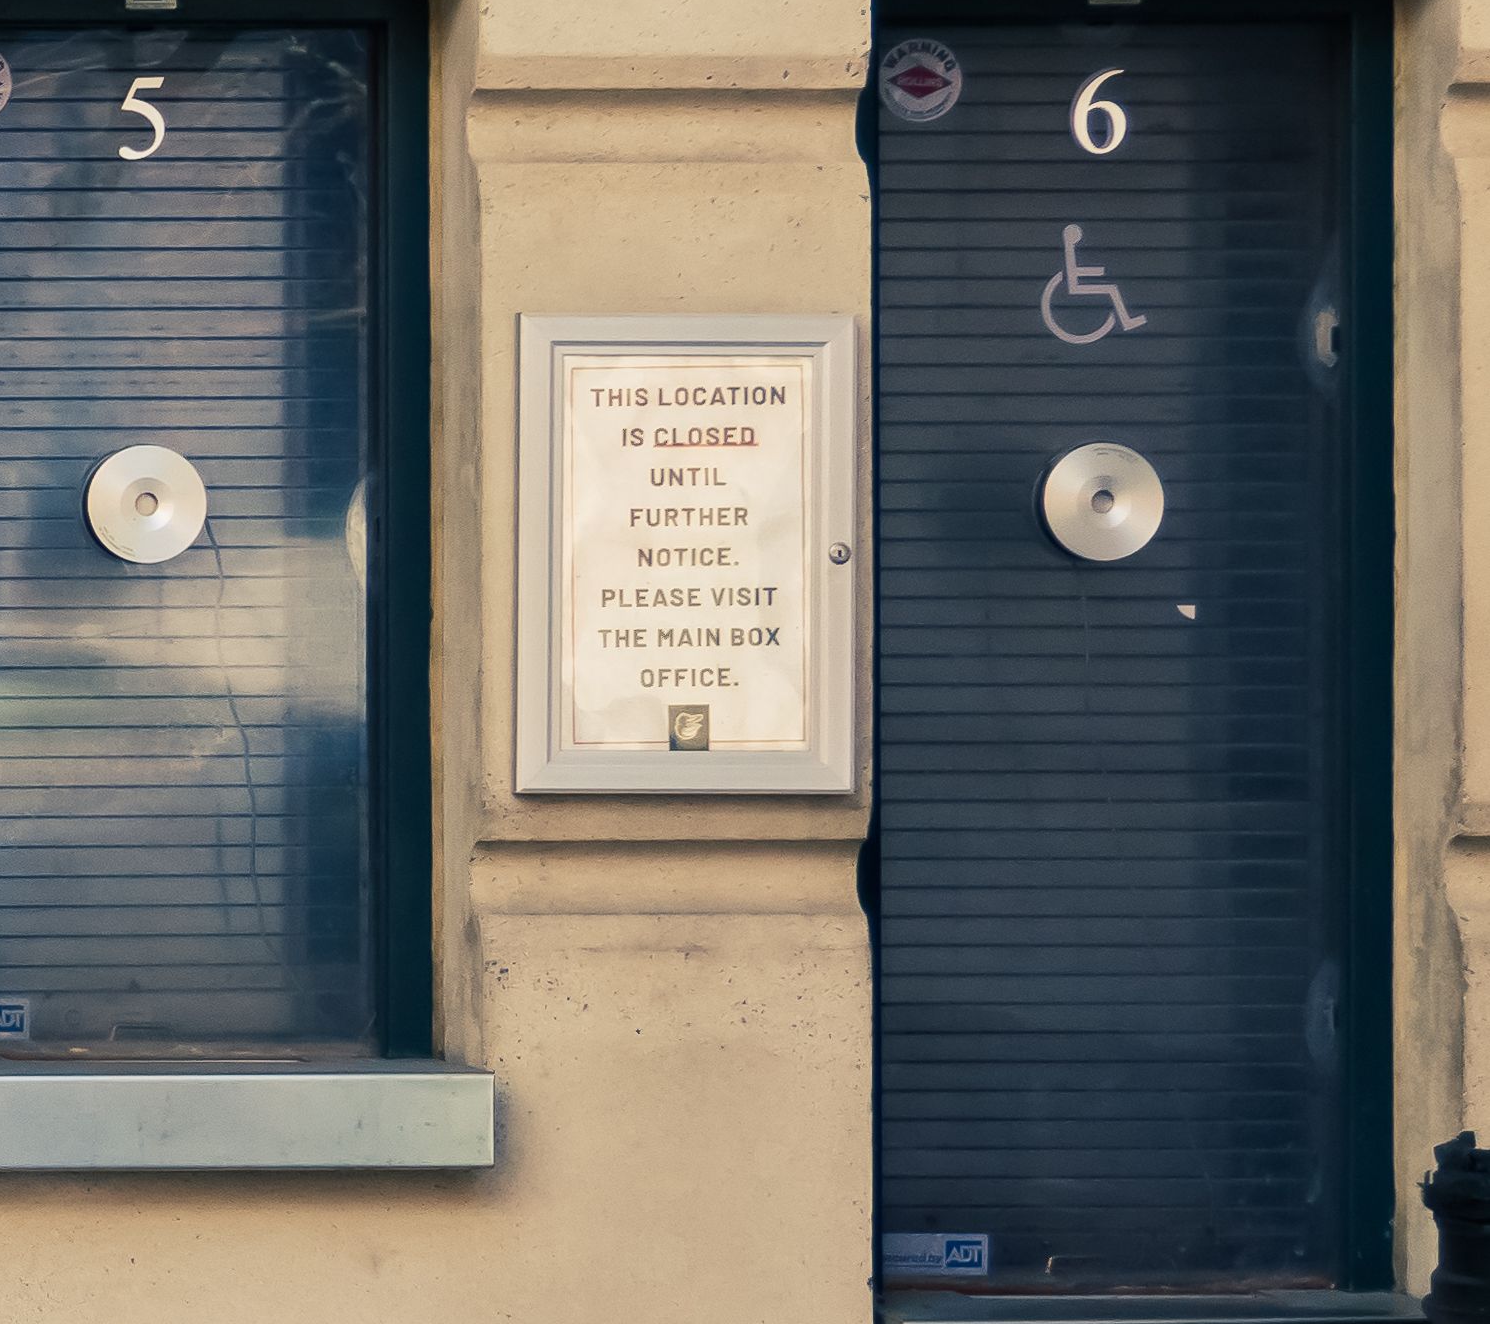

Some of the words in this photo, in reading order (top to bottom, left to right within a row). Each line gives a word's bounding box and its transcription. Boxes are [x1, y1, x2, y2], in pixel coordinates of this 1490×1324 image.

[118, 76, 166, 160] 5
[1072, 69, 1128, 155] 6
[590, 385, 649, 407] THIS
[658, 385, 786, 407] LOCATION
[622, 426, 645, 448] IS
[653, 426, 757, 448] CLOSED
[650, 467, 727, 487] UNTIL
[630, 507, 748, 527] FURTHER
[637, 547, 739, 567] NOTICE.
[601, 587, 702, 608] PLEASE
[711, 587, 778, 608] VISIT
[597, 627, 647, 648] THE
[657, 627, 721, 648] MAIN
[731, 627, 780, 648] BOX
[640, 667, 739, 688] OFFICE.
[946, 1244, 982, 1263] ADT
